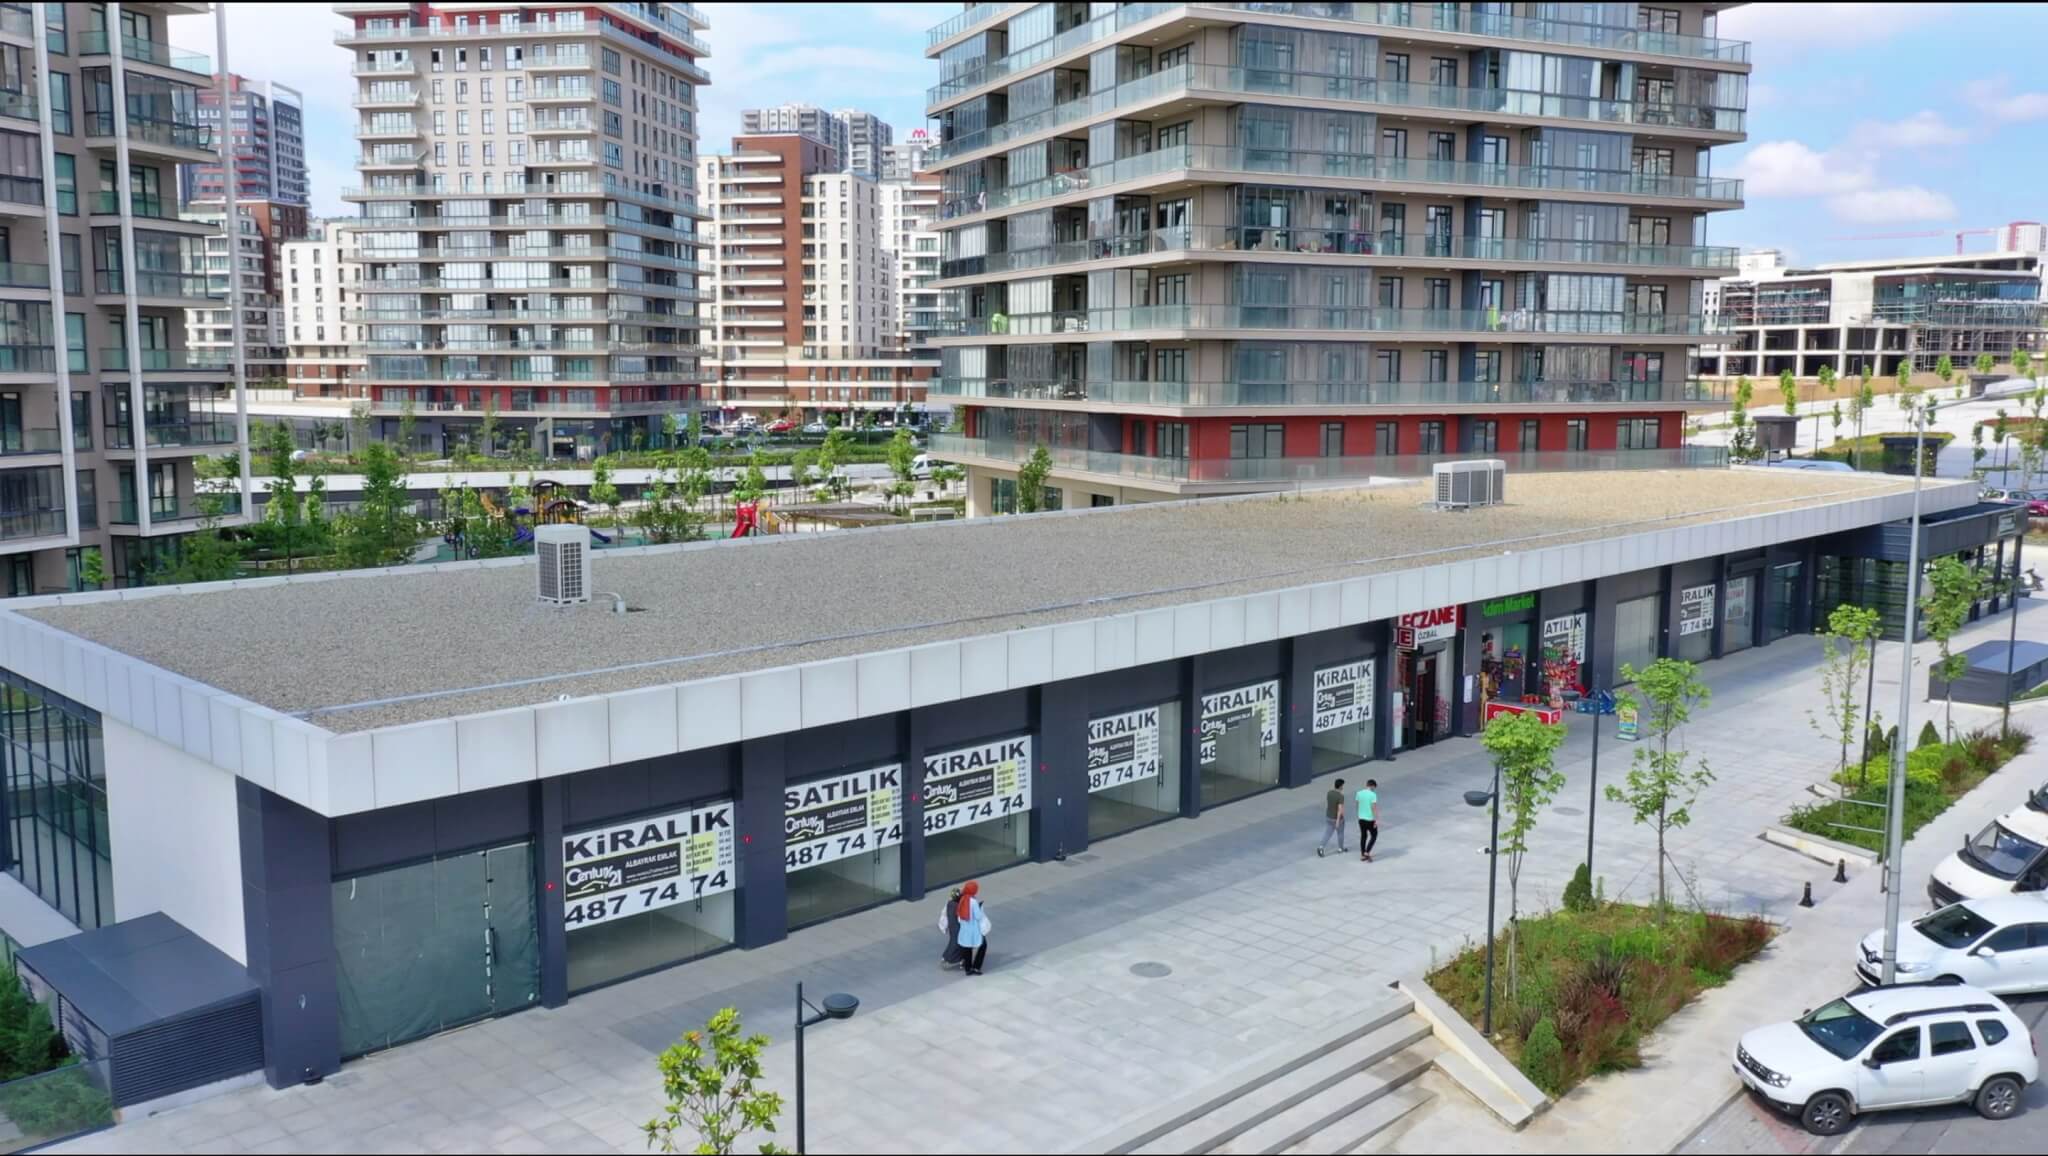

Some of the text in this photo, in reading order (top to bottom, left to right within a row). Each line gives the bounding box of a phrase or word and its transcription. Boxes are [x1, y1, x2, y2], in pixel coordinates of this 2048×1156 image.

[1400, 631, 1411, 644] E
[1316, 705, 1369, 728] 487 74 74
[1116, 765, 1133, 782] 74
[1138, 759, 1155, 776] 74
[785, 768, 898, 811] SATILIK
[924, 809, 960, 832] 487
[968, 801, 992, 820] 74
[1000, 793, 1024, 813] 74
[785, 842, 828, 868] 487
[837, 833, 866, 854] 74
[873, 824, 901, 845] 74
[608, 868, 622, 887] 21
[565, 895, 628, 924] 487
[640, 882, 679, 907] 74
[690, 870, 728, 895] 74
